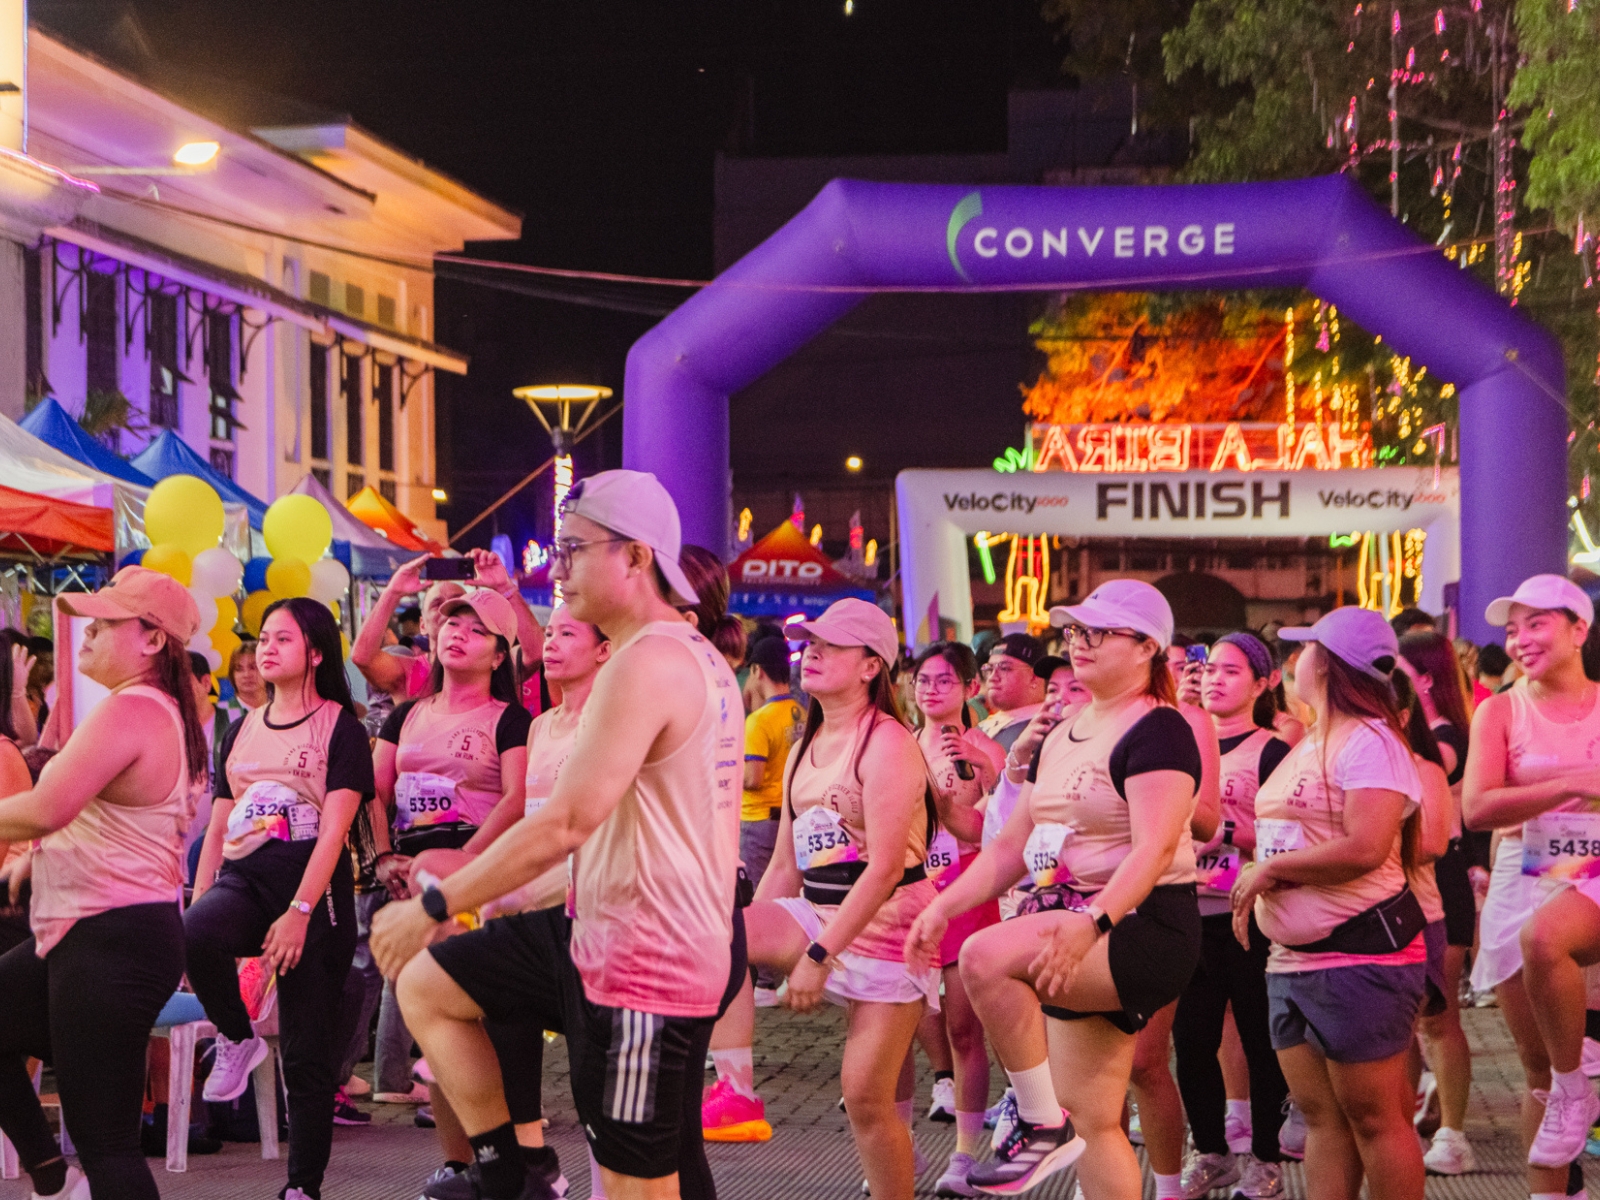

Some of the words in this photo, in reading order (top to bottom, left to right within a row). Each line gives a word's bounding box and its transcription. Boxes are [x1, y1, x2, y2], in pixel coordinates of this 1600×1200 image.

[973, 222, 1236, 259] CONVERGE
[1097, 480, 1290, 520] FINISH
[461, 735, 472, 751] 5
[298, 751, 308, 768] 5
[946, 773, 954, 788] 5
[1225, 779, 1234, 796] 5
[1293, 778, 1307, 797] 5
[409, 796, 452, 813] 5330
[808, 831, 850, 853] 5334
[1548, 838, 1600, 857] 5438
[1196, 855, 1230, 871] 174
